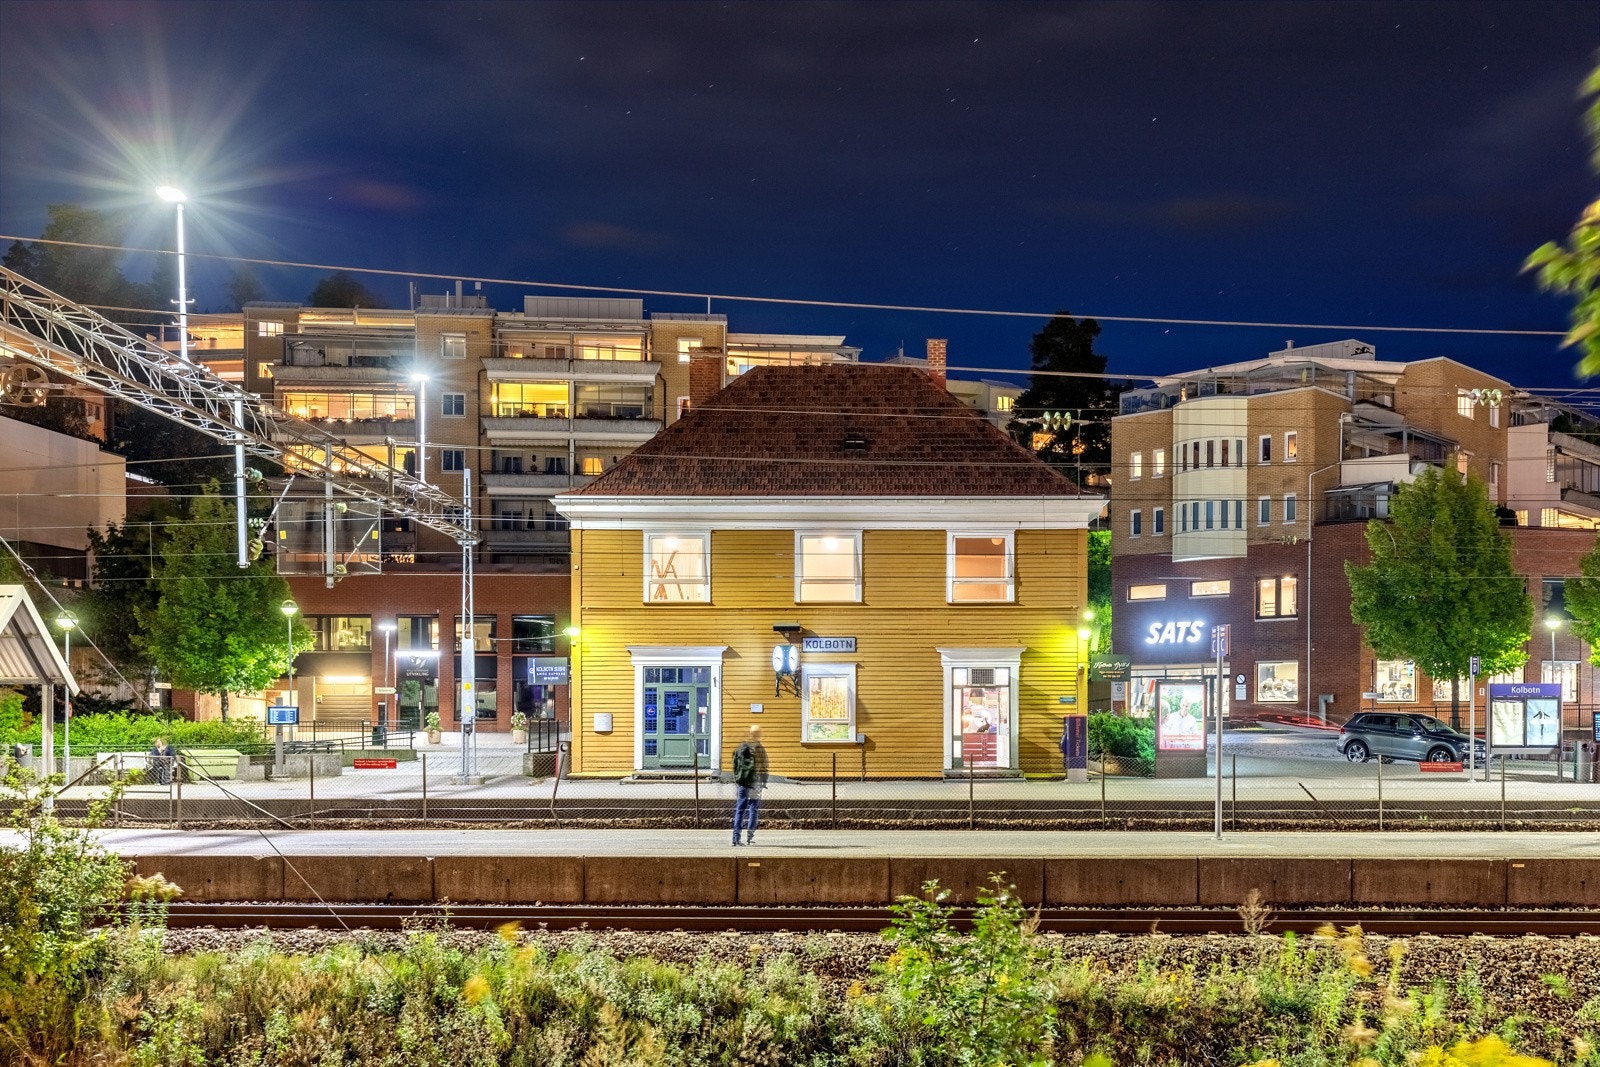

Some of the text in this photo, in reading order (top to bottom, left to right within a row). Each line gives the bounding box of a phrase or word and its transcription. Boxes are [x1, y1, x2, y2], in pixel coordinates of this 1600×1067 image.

[1145, 620, 1205, 645] SATS
[805, 640, 853, 649] KOLBOTN
[1511, 686, 1541, 694] Kolbotn
